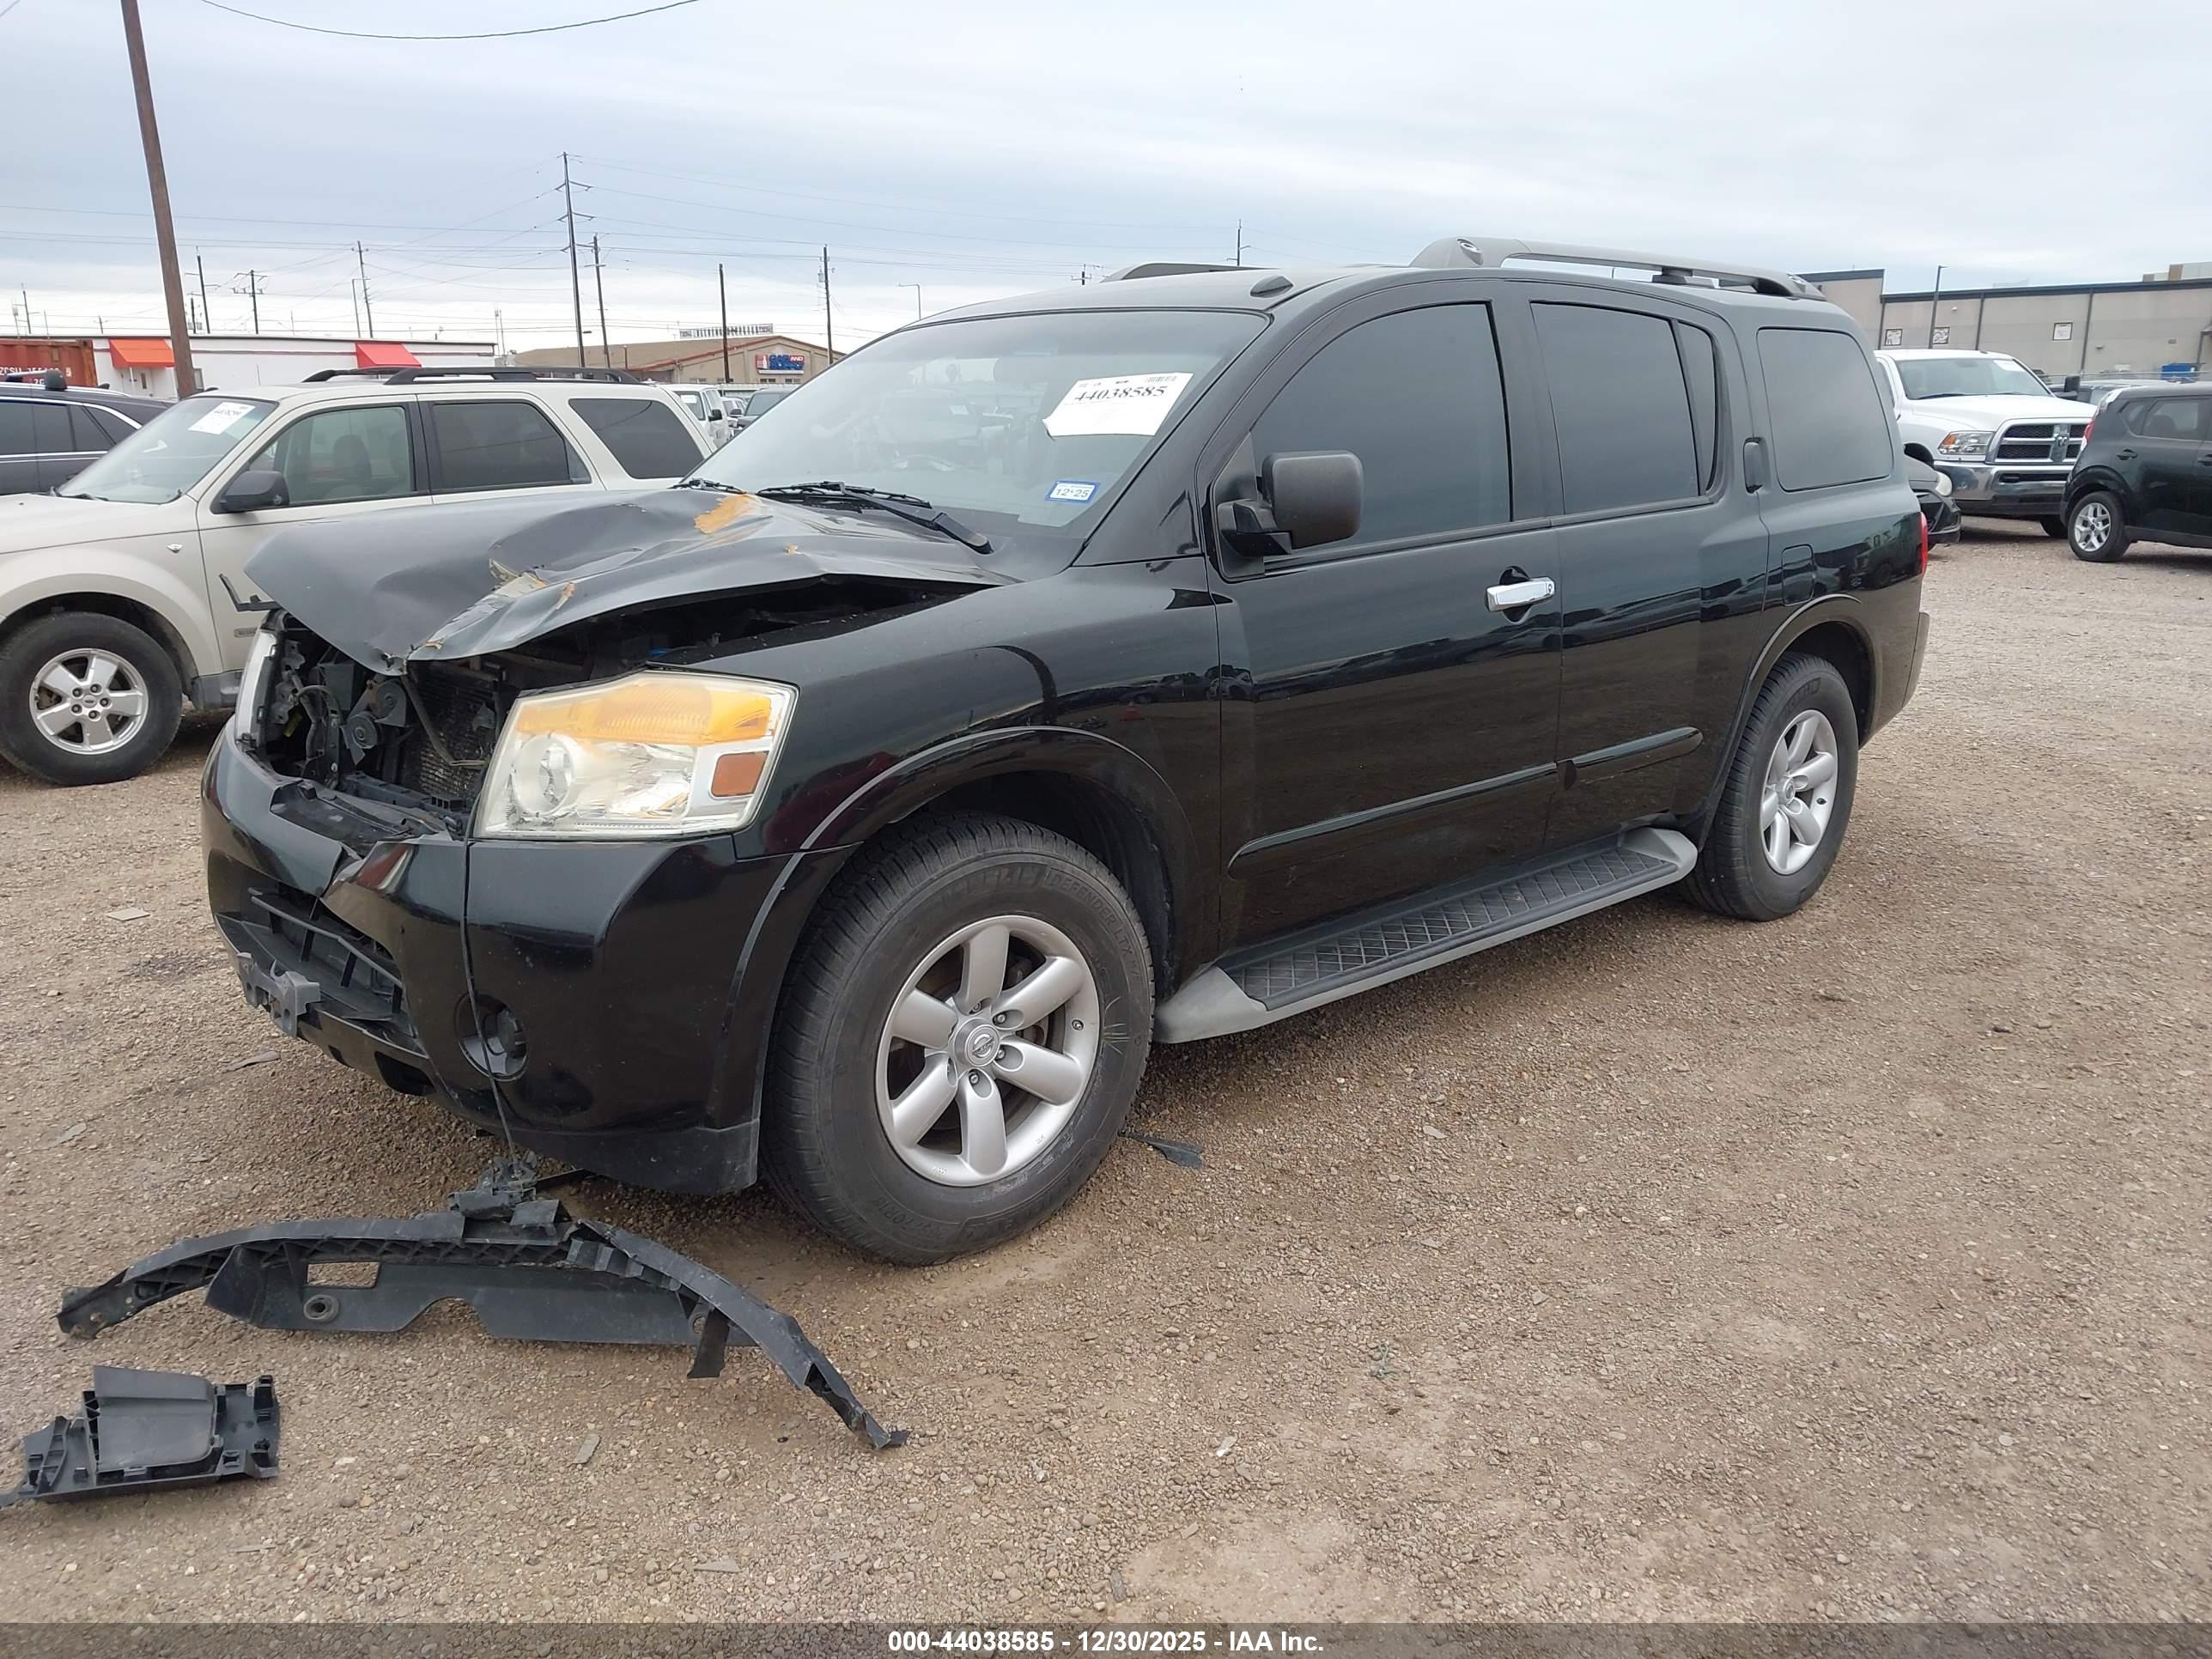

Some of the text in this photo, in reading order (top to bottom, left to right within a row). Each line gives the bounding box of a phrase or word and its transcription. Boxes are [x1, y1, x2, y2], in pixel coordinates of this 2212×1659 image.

[1074, 386, 1168, 401] 44038585
[1051, 871, 1117, 927] DEFENDER
[1114, 926, 1133, 957] LTX
